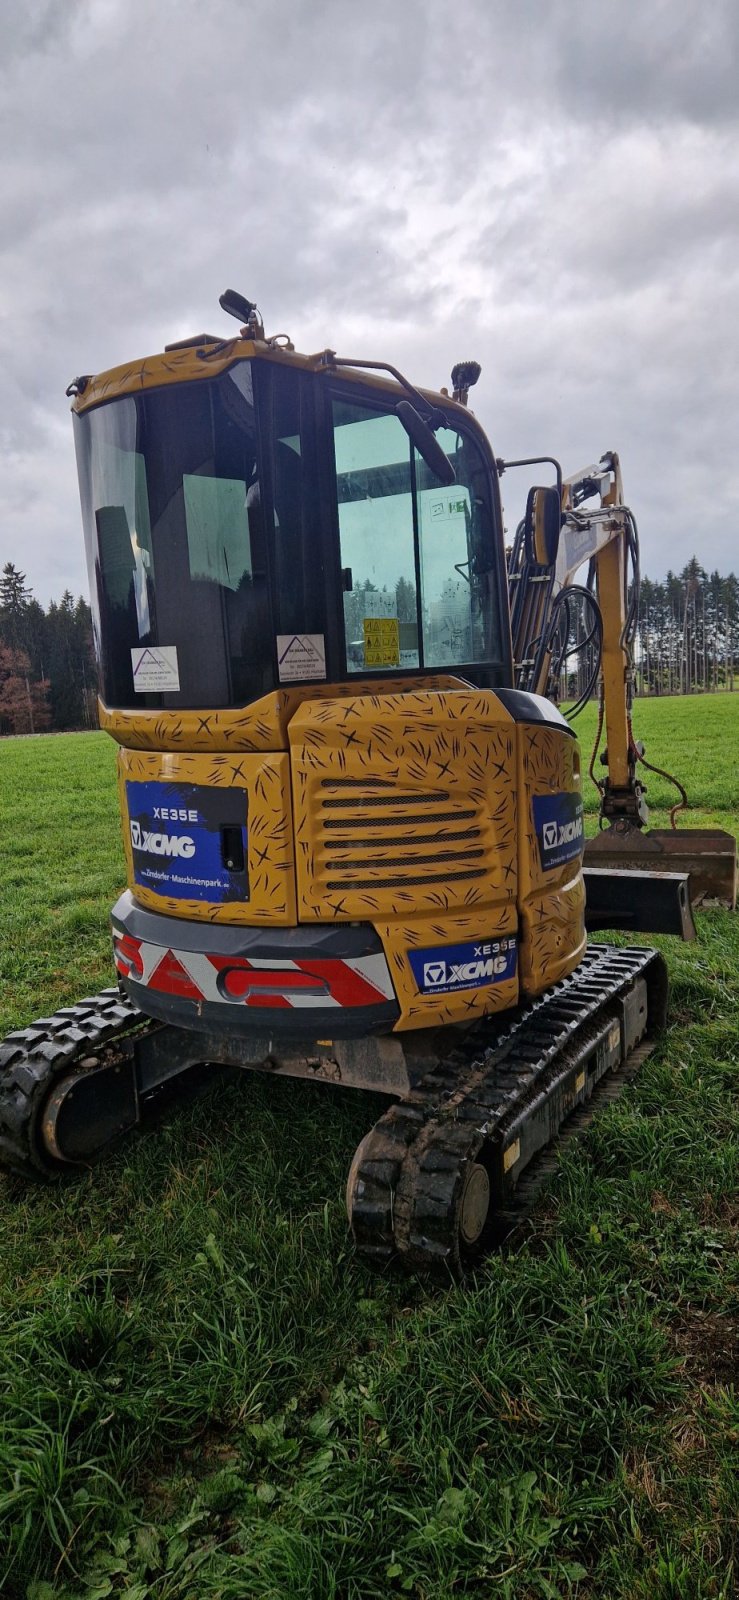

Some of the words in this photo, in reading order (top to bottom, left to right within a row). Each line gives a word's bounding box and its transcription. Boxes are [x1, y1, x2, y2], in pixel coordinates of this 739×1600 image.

[153, 807, 199, 822] XE35E
[141, 830, 196, 859] XCMG
[473, 939, 516, 957] XE35E
[446, 955, 508, 984] XCMG
